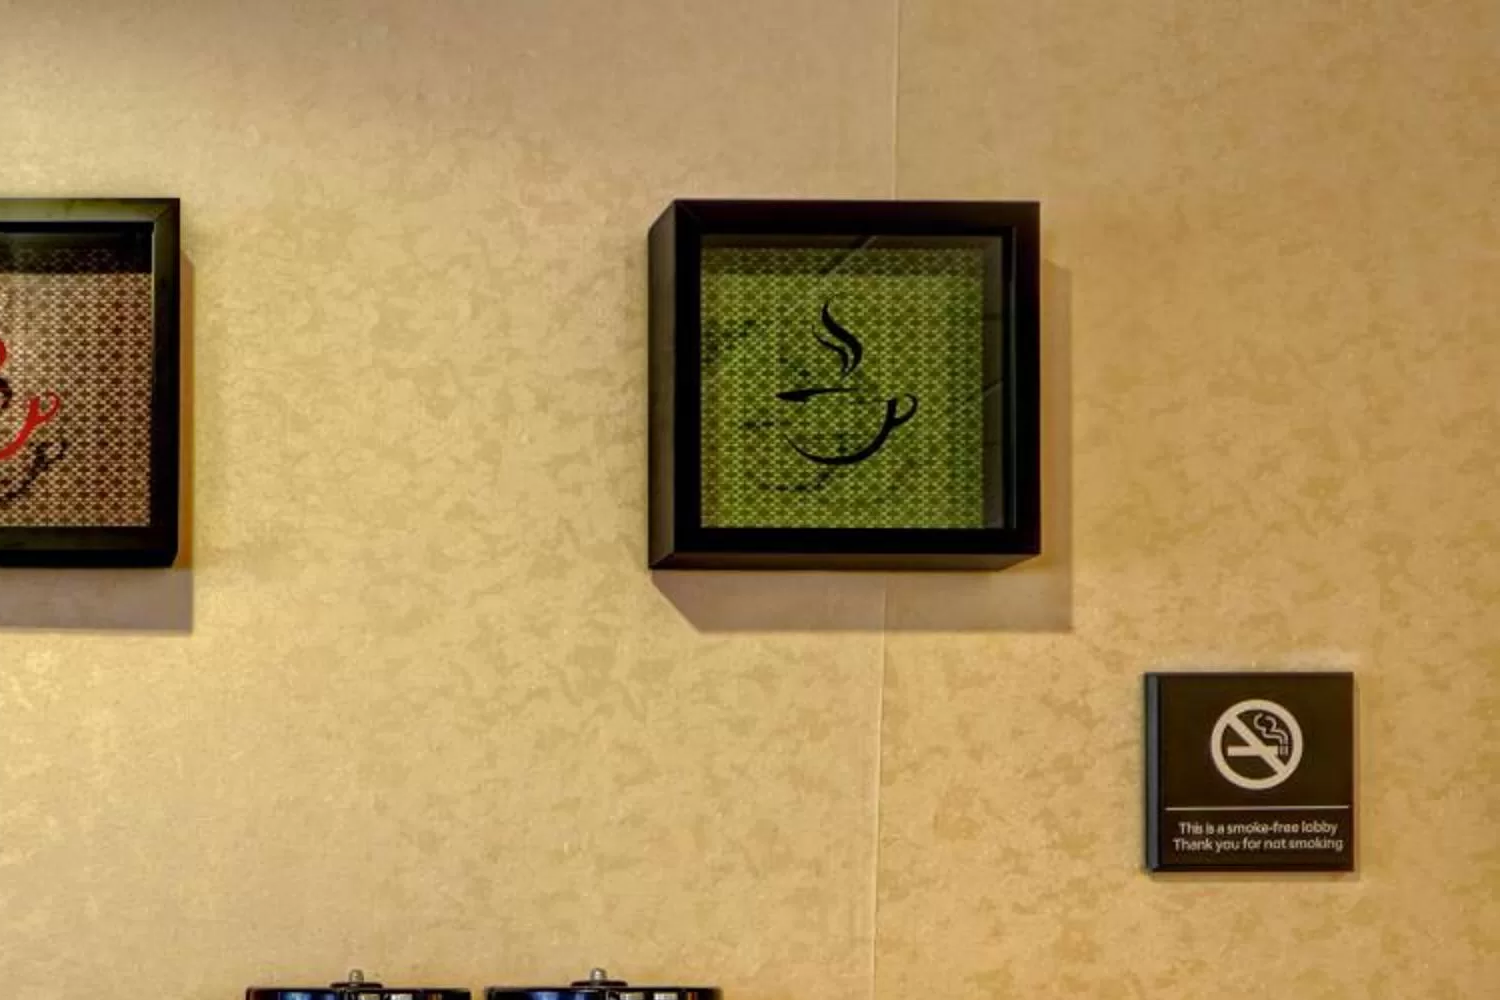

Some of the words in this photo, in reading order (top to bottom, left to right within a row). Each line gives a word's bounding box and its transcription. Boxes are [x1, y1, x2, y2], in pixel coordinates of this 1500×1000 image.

[1178, 821, 1203, 835] This
[1206, 821, 1215, 835] is
[1217, 824, 1225, 835] a
[1227, 821, 1299, 835] smoke-free
[1301, 820, 1338, 837] lobby
[1172, 838, 1213, 851] Thank
[1216, 841, 1240, 853] you
[1242, 837, 1261, 849] for
[1263, 838, 1287, 849] not
[1288, 837, 1344, 852] smoking
